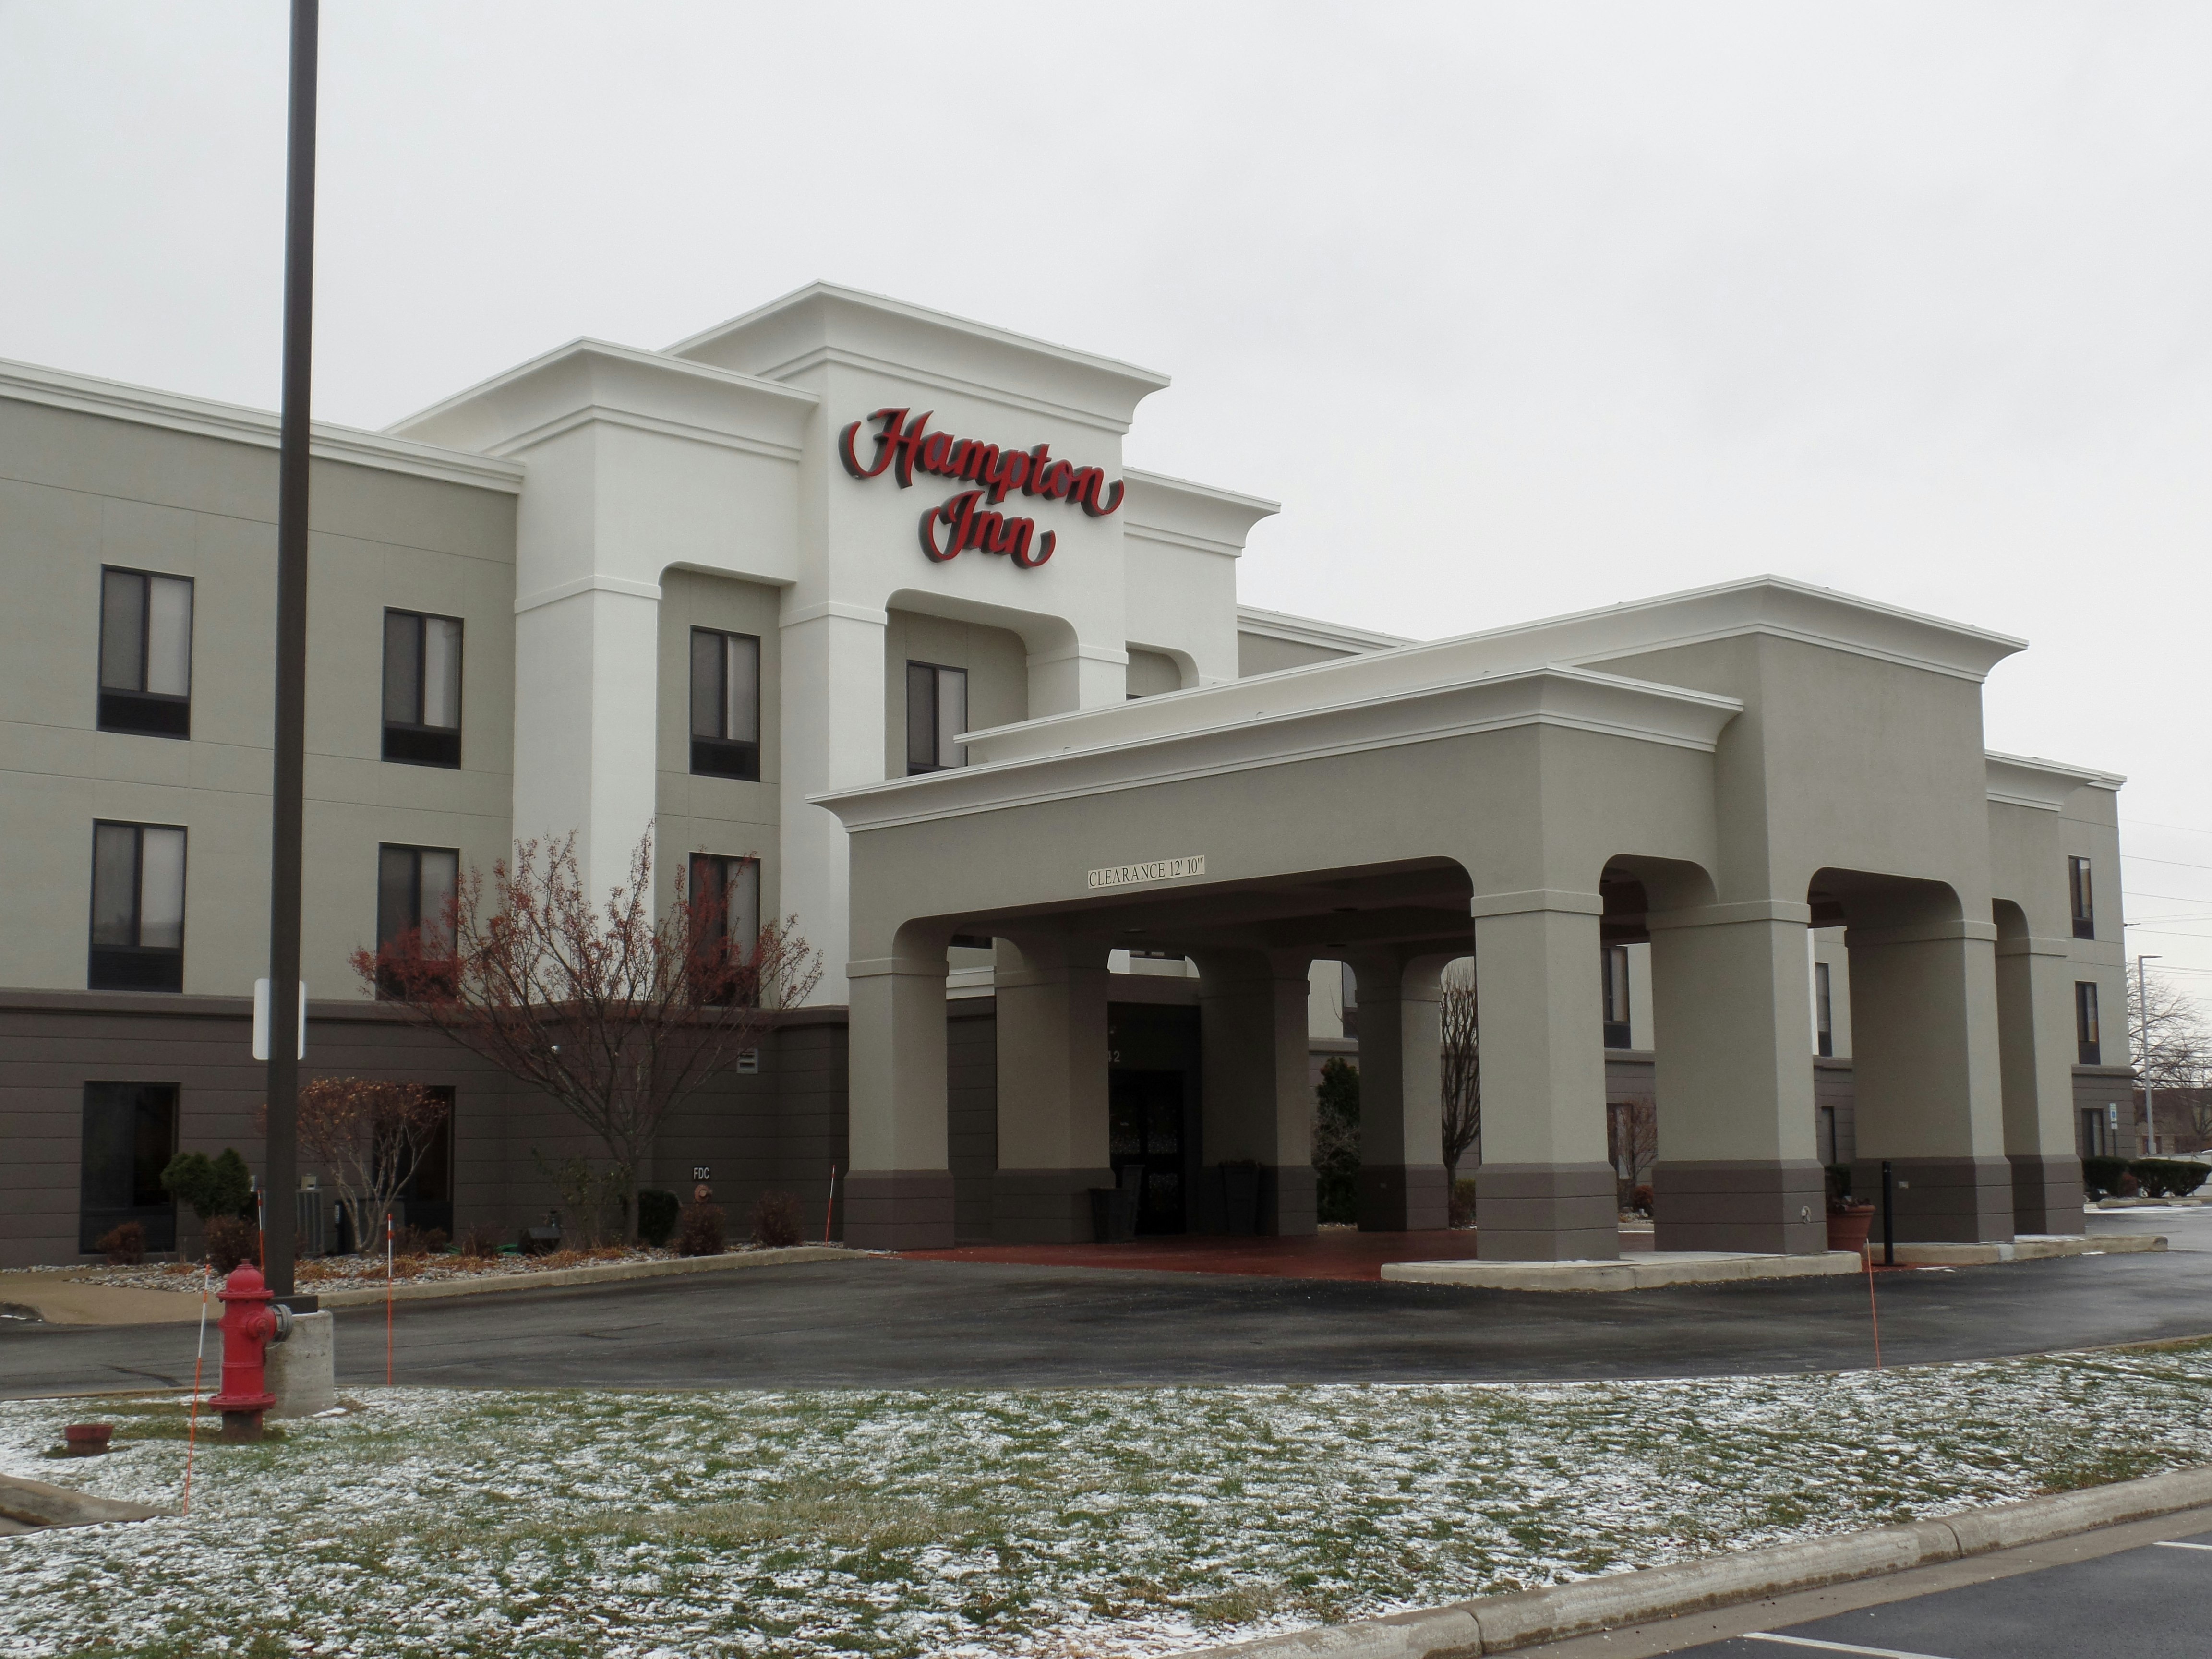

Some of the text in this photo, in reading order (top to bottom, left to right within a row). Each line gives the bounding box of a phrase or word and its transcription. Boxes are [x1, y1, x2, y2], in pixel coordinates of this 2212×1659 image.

[838, 407, 1124, 517] Hampton
[918, 490, 1056, 569] Inn
[1089, 857, 1202, 887] CLEARANCE 12' 10"
[693, 1167, 710, 1179] FDC
